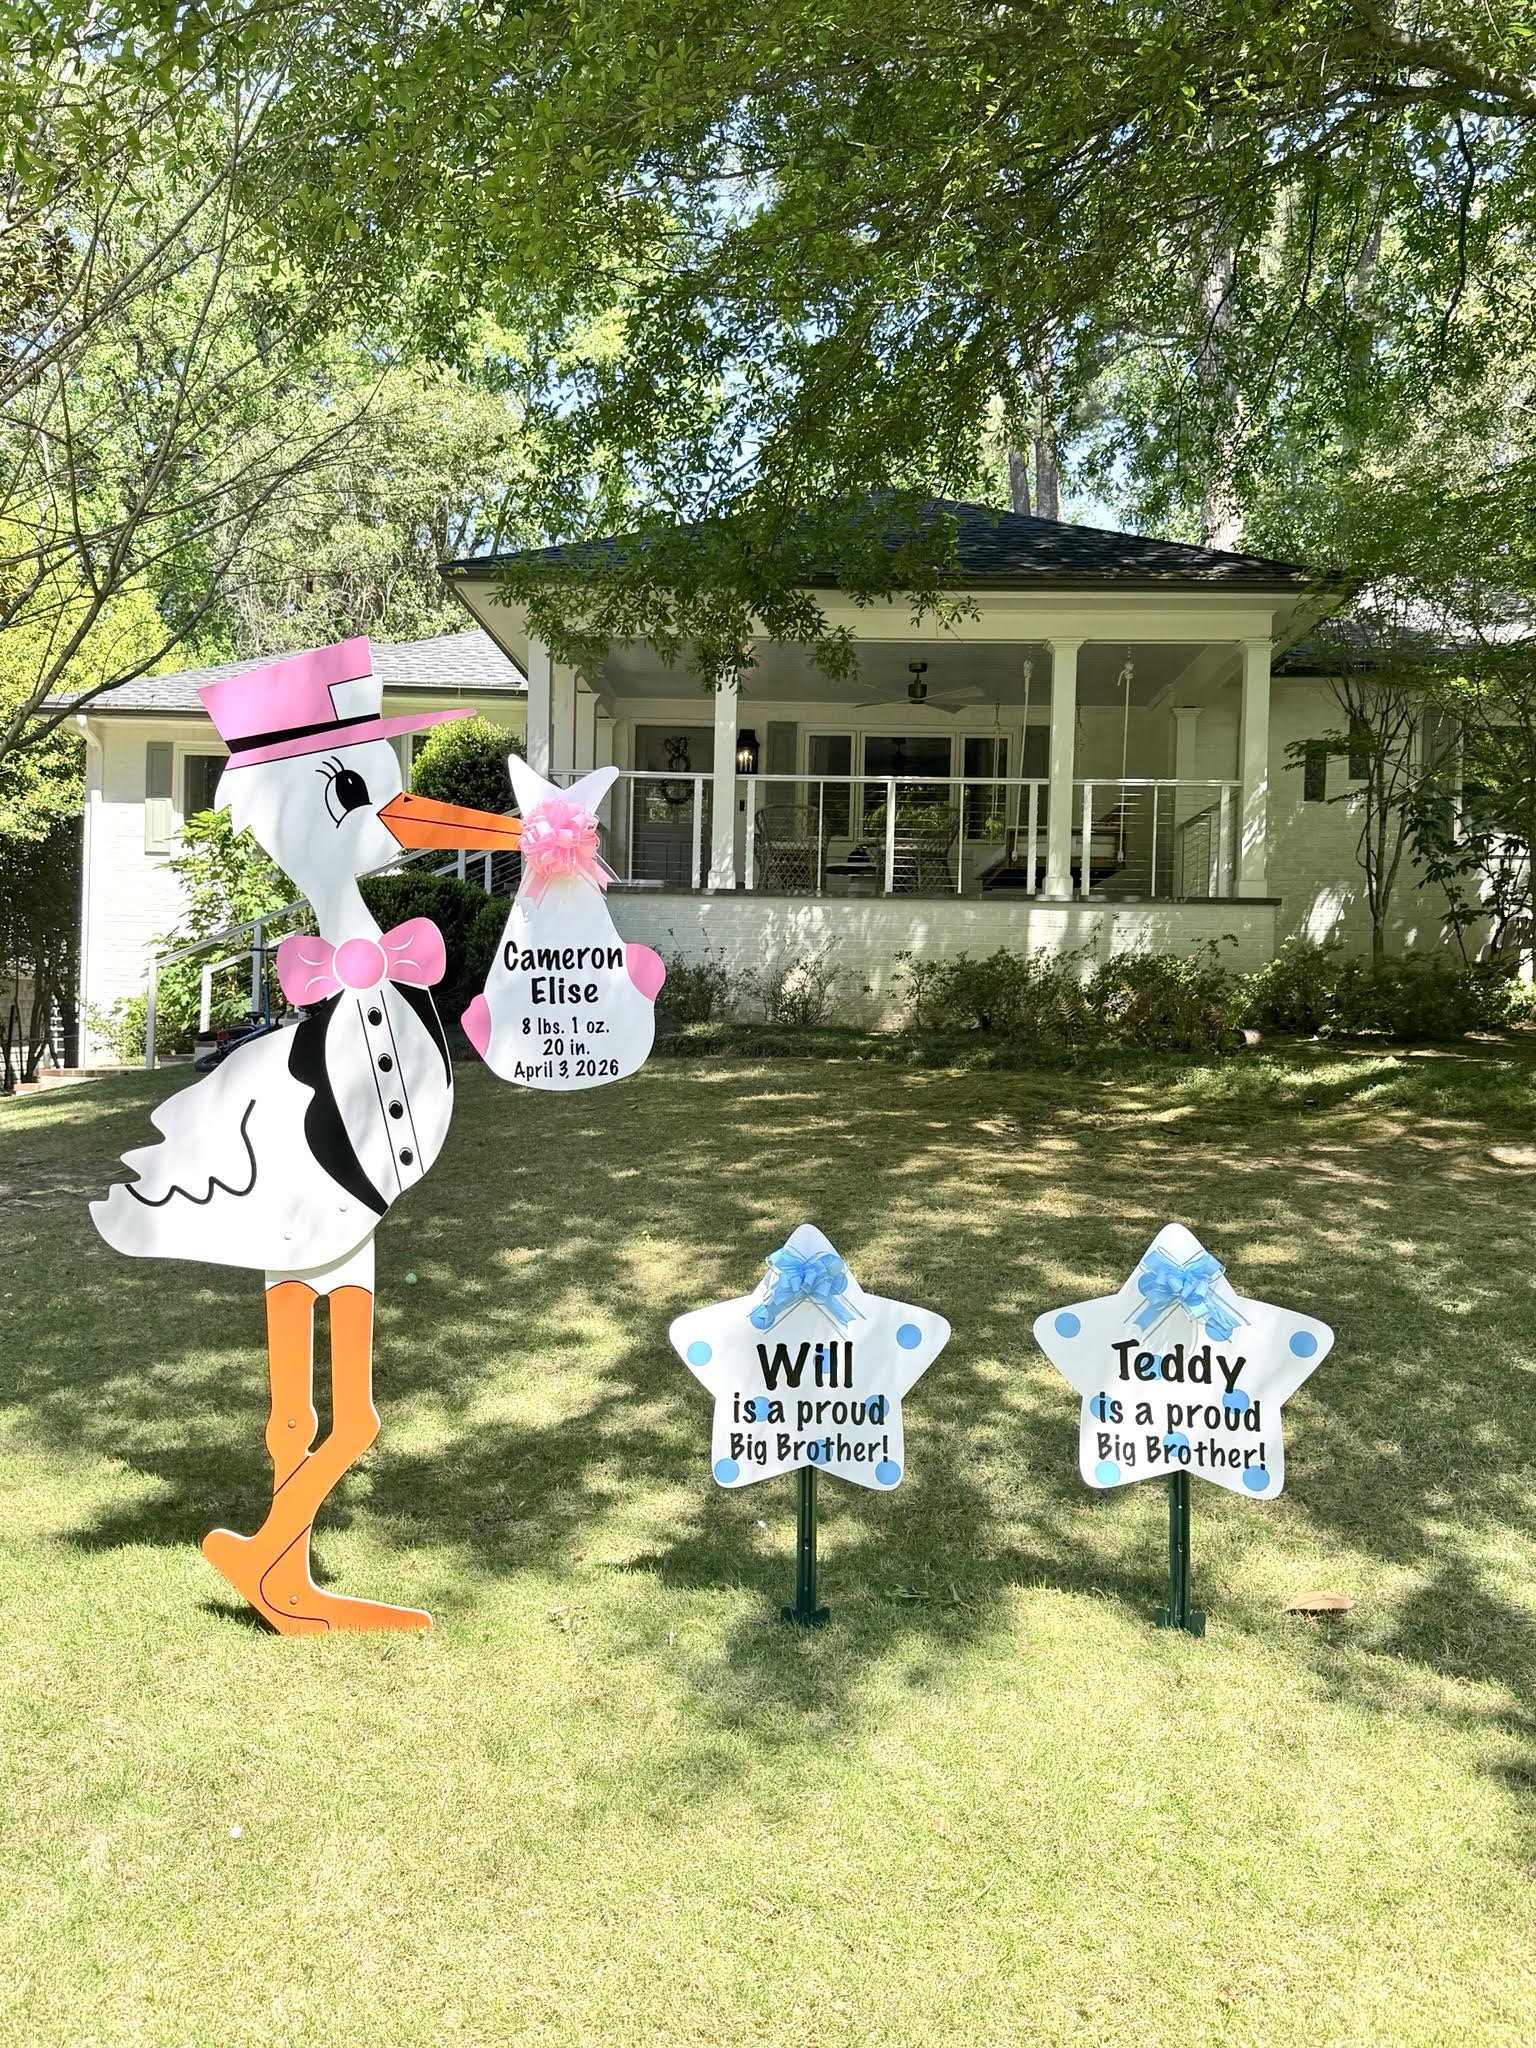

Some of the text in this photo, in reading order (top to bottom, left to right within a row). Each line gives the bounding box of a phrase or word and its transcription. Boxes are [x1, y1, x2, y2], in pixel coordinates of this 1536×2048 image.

[504, 941, 623, 971] Cameron
[531, 976, 599, 1005] Elise
[522, 1016, 610, 1035] 8 lbs. 1 oz.
[542, 1038, 590, 1056] 20 in.
[514, 1058, 619, 1082] April 3, 2026
[756, 1340, 854, 1391] Will
[1110, 1338, 1247, 1394] Teddy
[733, 1391, 885, 1432] is a proud
[1099, 1391, 1261, 1435] is a proud
[730, 1432, 889, 1466] Big Brother!
[1096, 1432, 1265, 1471] Big Brother!
